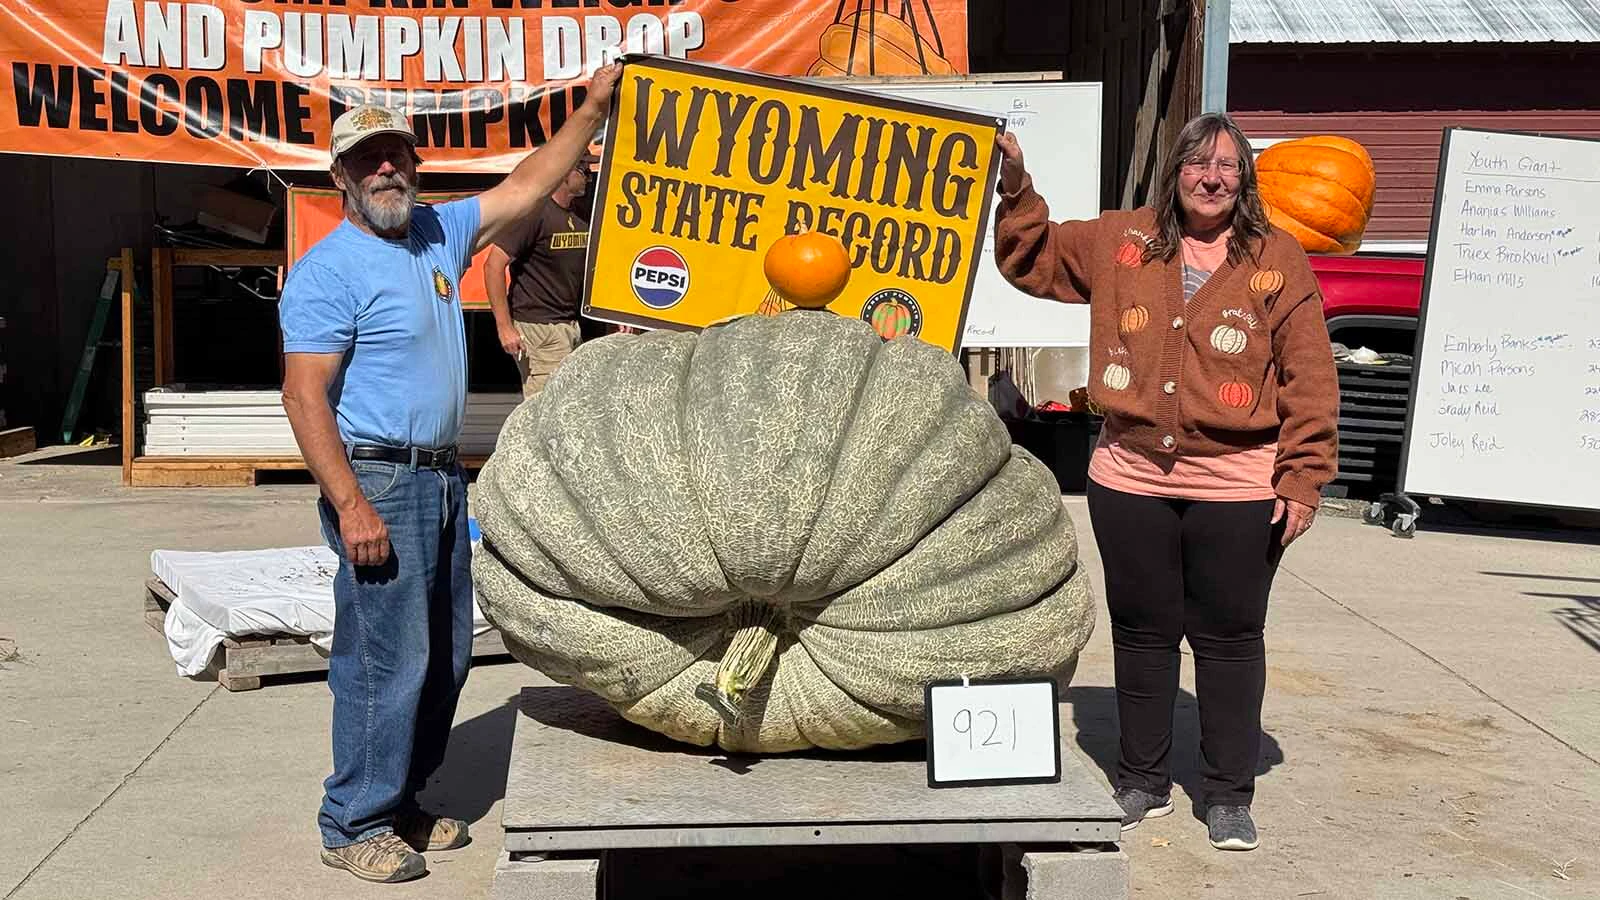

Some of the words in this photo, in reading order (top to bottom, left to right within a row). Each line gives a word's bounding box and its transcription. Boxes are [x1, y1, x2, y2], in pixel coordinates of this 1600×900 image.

[103, 0, 227, 71] AND
[243, 9, 527, 82] PUMPKIN
[542, 12, 704, 81] DROP
[12, 61, 315, 145] WELCOME
[633, 75, 979, 220] WYOMING
[1470, 150, 1509, 171] Youth
[1518, 156, 1561, 173] Giant
[1465, 179, 1501, 194] Emma
[1505, 183, 1546, 198] Parsons
[616, 170, 765, 252] STATE
[552, 233, 588, 249] WYOMIN
[634, 267, 686, 289] PEPSI
[1453, 268, 1492, 284] Ethan
[1440, 359, 1482, 377] Micah
[1471, 432, 1505, 452] Reid
[952, 708, 1017, 751] 921
